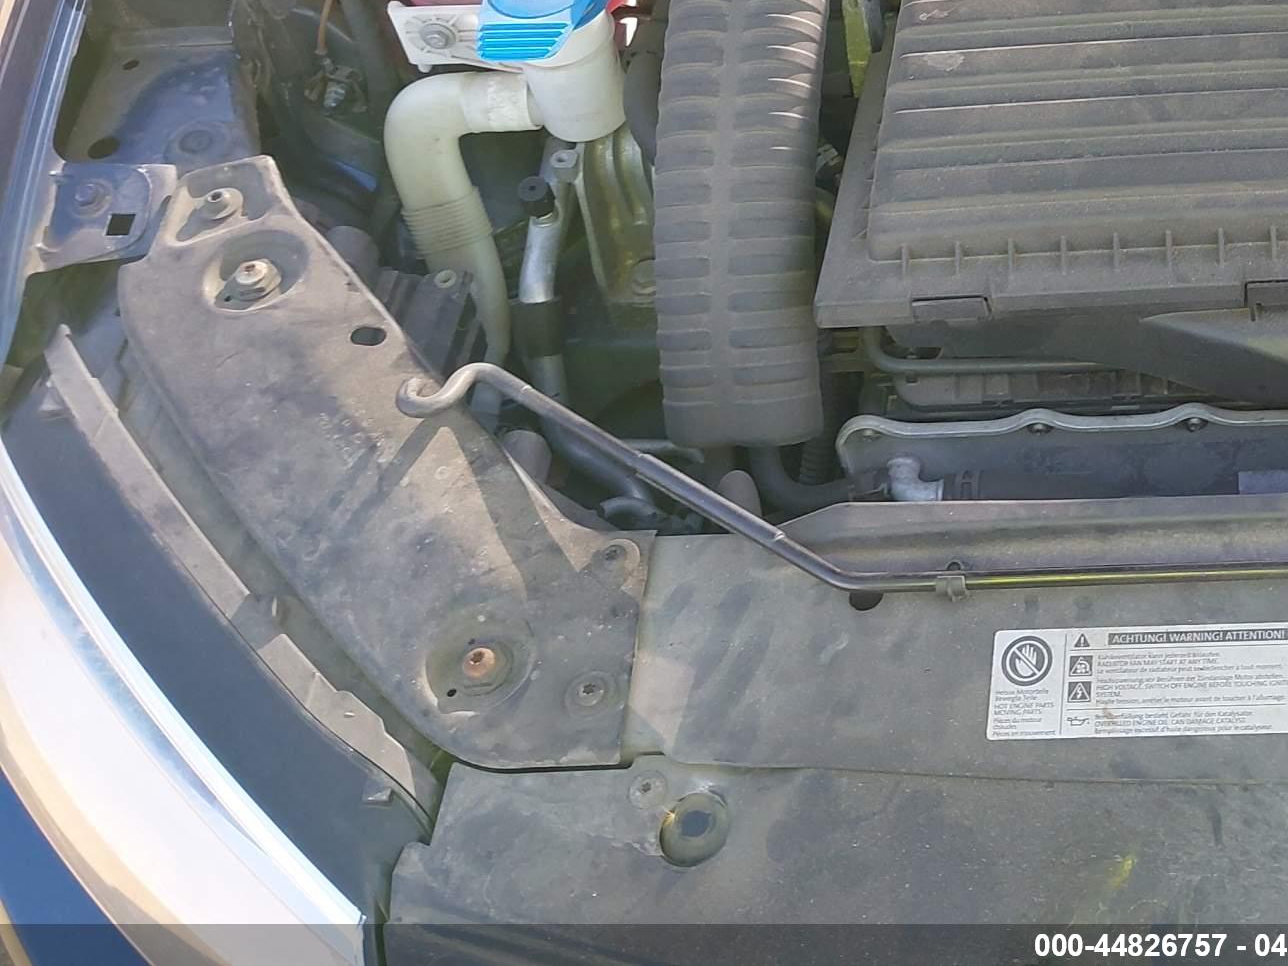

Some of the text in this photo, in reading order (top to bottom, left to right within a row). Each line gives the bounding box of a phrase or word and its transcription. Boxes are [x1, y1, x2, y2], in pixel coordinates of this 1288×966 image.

[1112, 629, 1285, 644] ACHTUNG! WARNING! ATTENTION!
